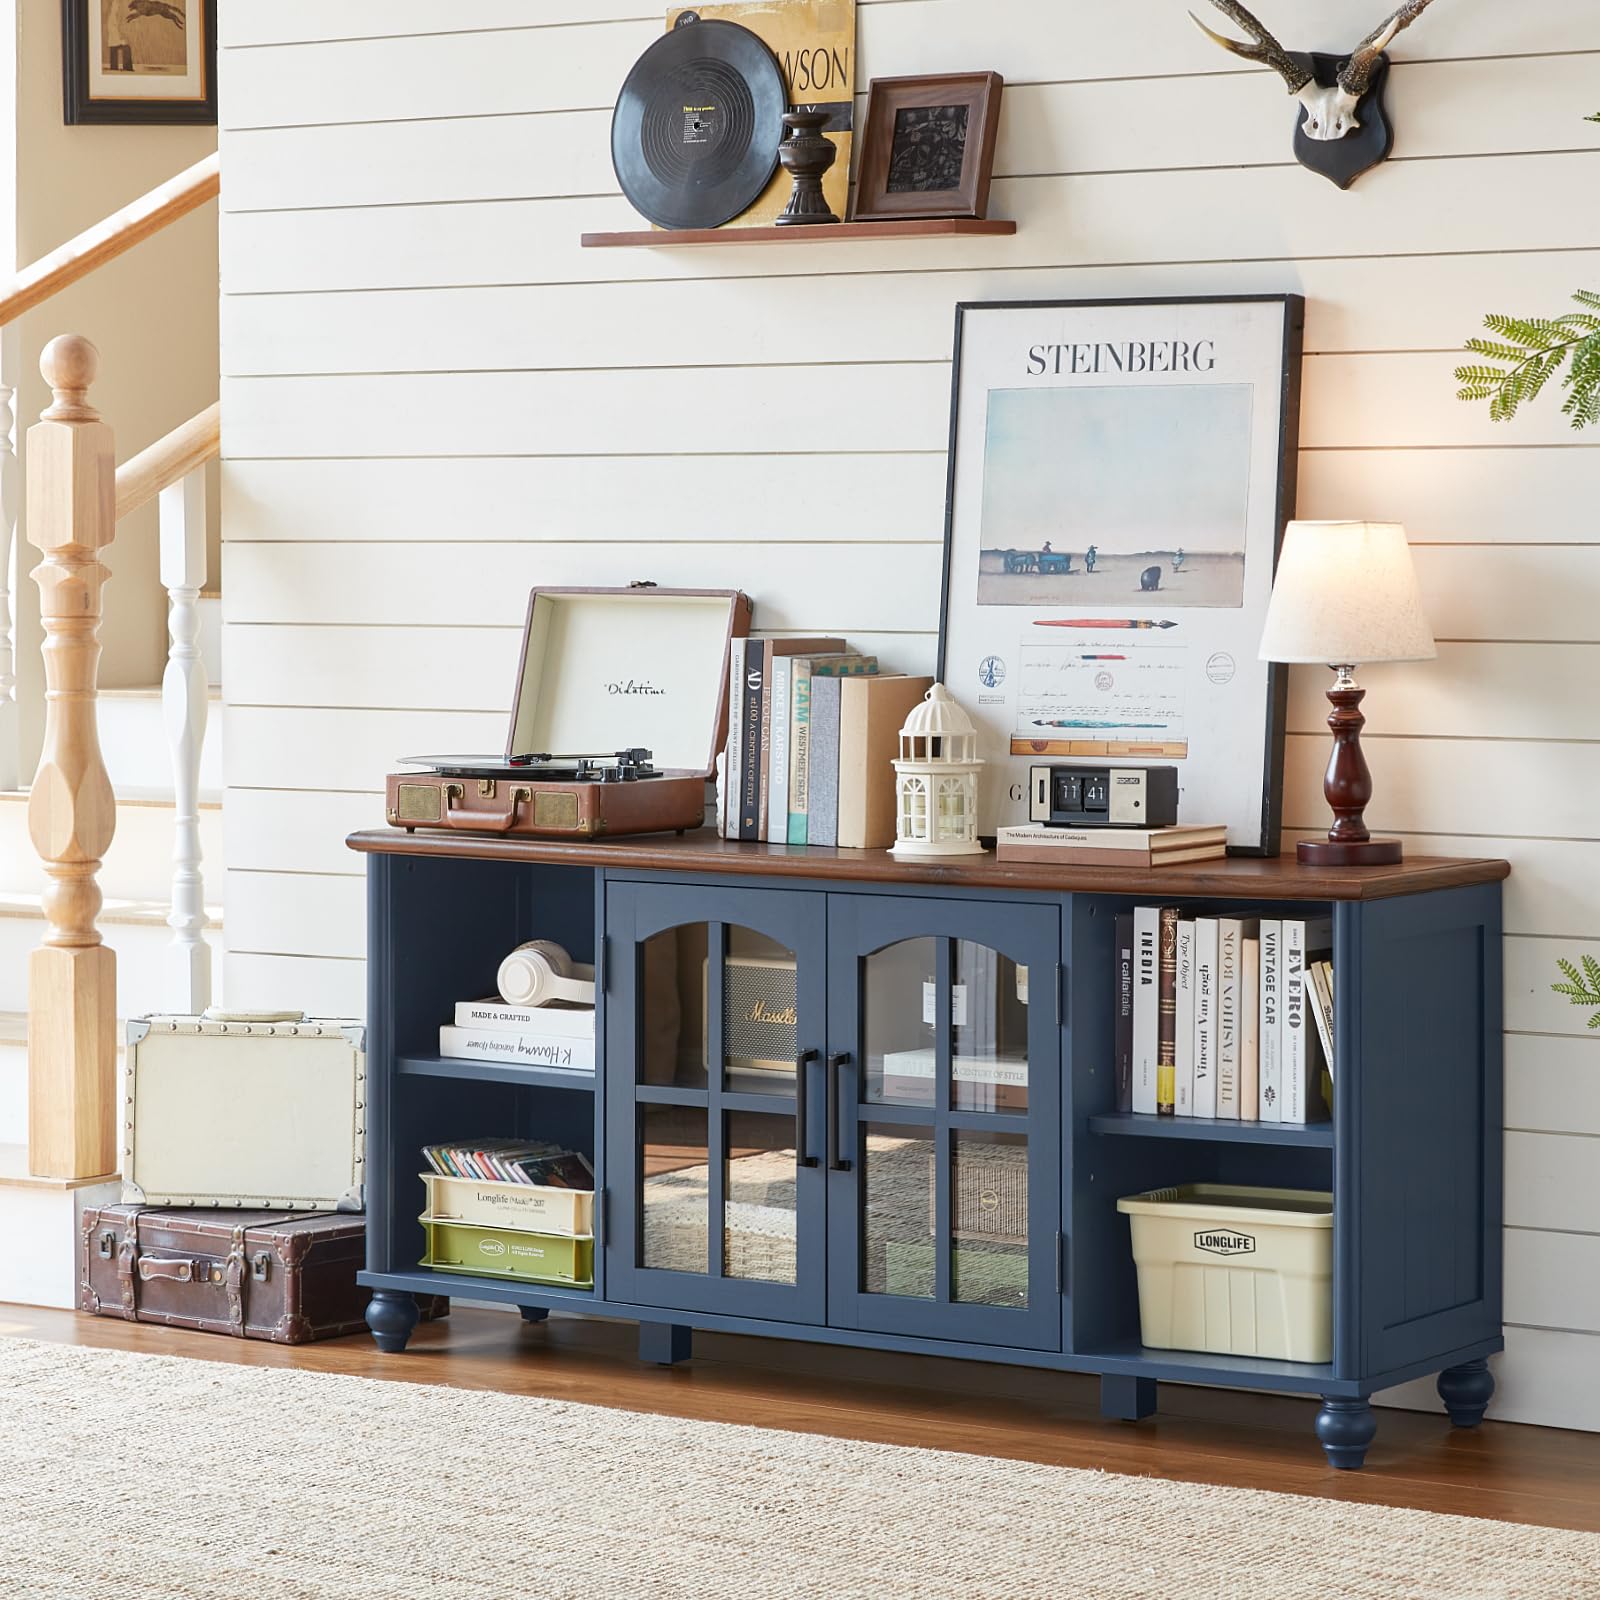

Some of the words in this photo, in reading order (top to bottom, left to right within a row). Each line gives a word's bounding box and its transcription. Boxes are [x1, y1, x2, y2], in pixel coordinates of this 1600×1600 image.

[1027, 340, 1216, 376] STEINBERG
[748, 666, 762, 690] AD
[764, 687, 771, 697] IF
[797, 679, 809, 722] CAM
[762, 699, 770, 724] YOU
[748, 730, 756, 768] CENTURY
[761, 727, 769, 751] CAN
[748, 770, 755, 782] OF
[746, 782, 754, 806] STYLE
[1063, 785, 1077, 799] 11
[1087, 786, 1104, 800] 41
[1141, 931, 1152, 985] INEDIA
[1180, 934, 1190, 957] Type
[1223, 931, 1234, 979] BOOK
[1180, 959, 1190, 990] Object
[1265, 933, 1276, 993] VINTAGE
[1199, 964, 1211, 996] gogh
[1289, 949, 1301, 1028] EVERO
[471, 1011, 492, 1019] MADE
[499, 1013, 530, 1022] CRAFTED
[1198, 999, 1208, 1025] Van
[1222, 985, 1233, 1064] FASHION
[1265, 997, 1276, 1025] CAR
[1197, 1030, 1208, 1079] Vincent
[959, 1068, 992, 1078] CENTURY
[993, 1071, 1002, 1080] OF
[1004, 1072, 1024, 1081] STYLE
[1221, 1068, 1232, 1104] THE
[477, 1192, 508, 1204] Longlife
[1199, 1235, 1250, 1250] LONGLIFE
